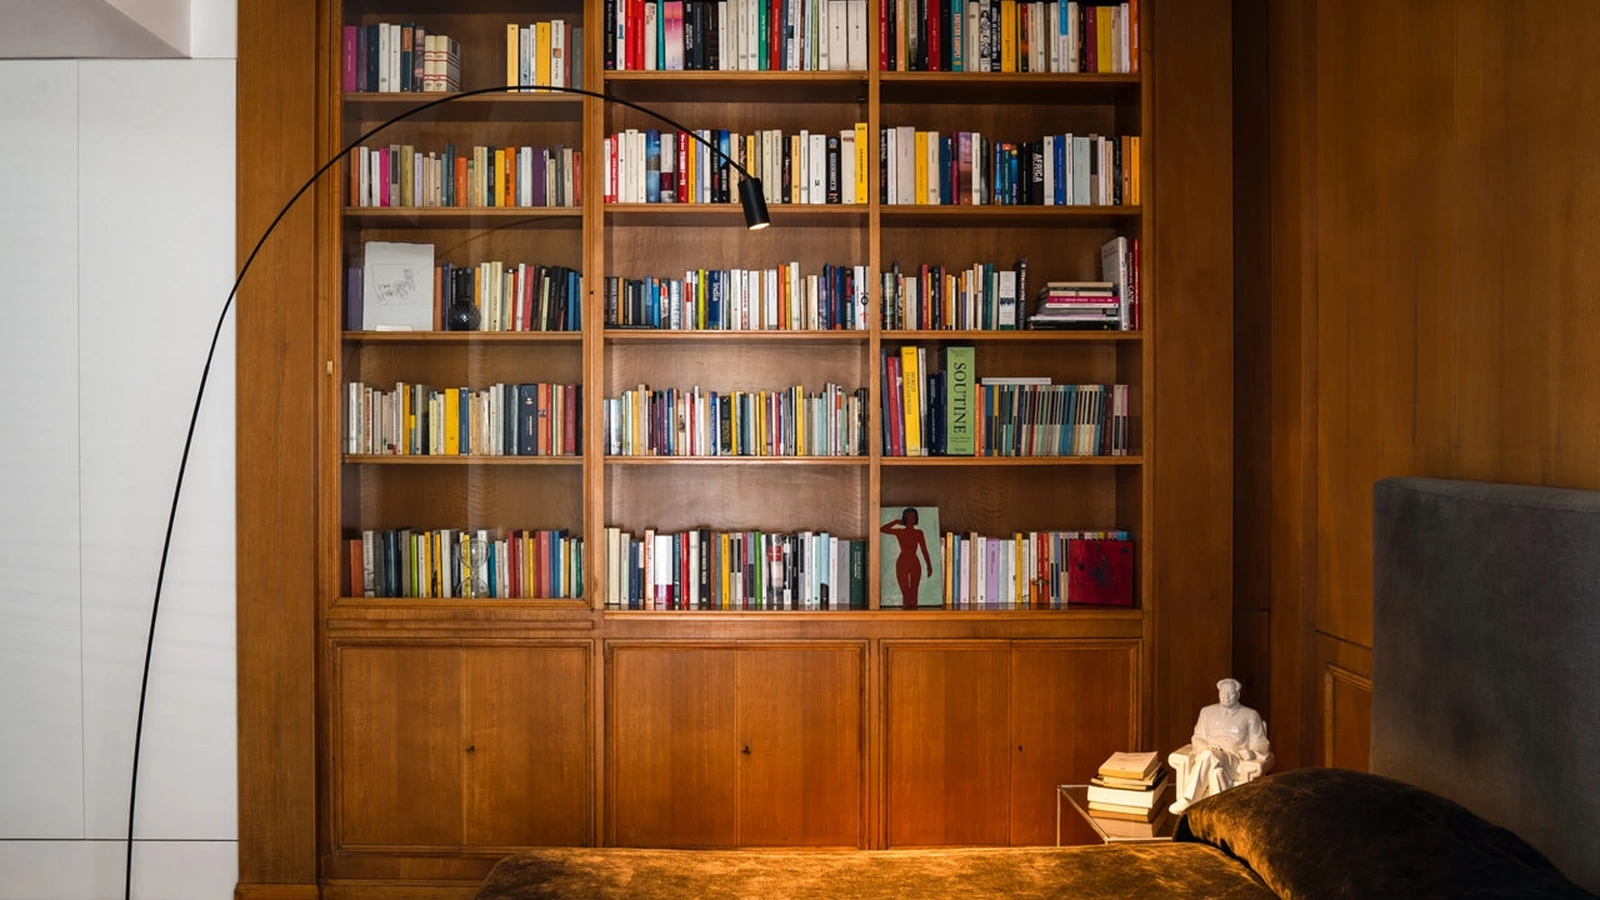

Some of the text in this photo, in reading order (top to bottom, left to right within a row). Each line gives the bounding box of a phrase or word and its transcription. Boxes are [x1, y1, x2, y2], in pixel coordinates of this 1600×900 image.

[1032, 152, 1043, 183] AFRICA
[712, 282, 721, 302] India
[953, 362, 967, 433] SOUTINE
